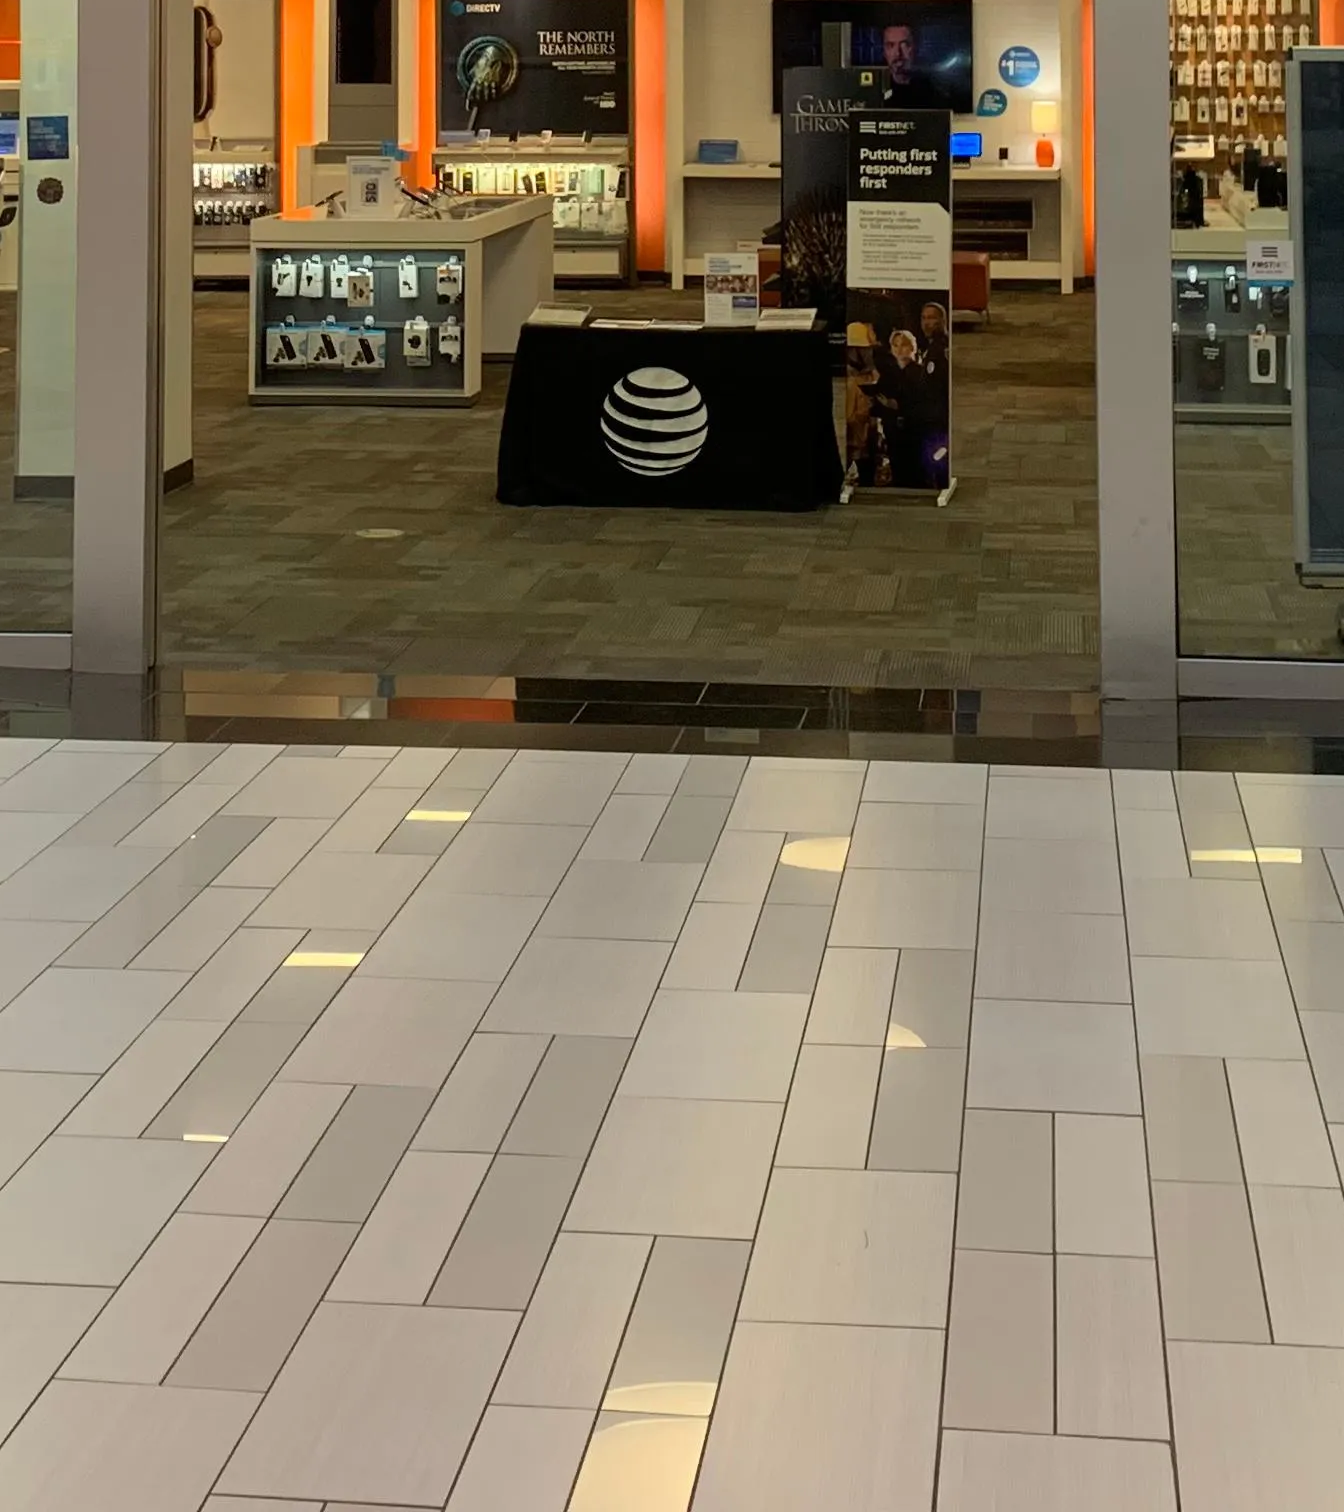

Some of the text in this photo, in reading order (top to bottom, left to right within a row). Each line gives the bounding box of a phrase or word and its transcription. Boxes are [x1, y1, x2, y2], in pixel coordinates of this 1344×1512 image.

[466, 4, 501, 13] DIRECTV
[537, 31, 615, 43] THE NORTH
[539, 43, 616, 55] REMEMBERS
[796, 95, 851, 114] GAME
[792, 114, 850, 134] THRON
[860, 148, 938, 162] Putting first
[860, 164, 932, 177] responders
[860, 176, 887, 189] first
